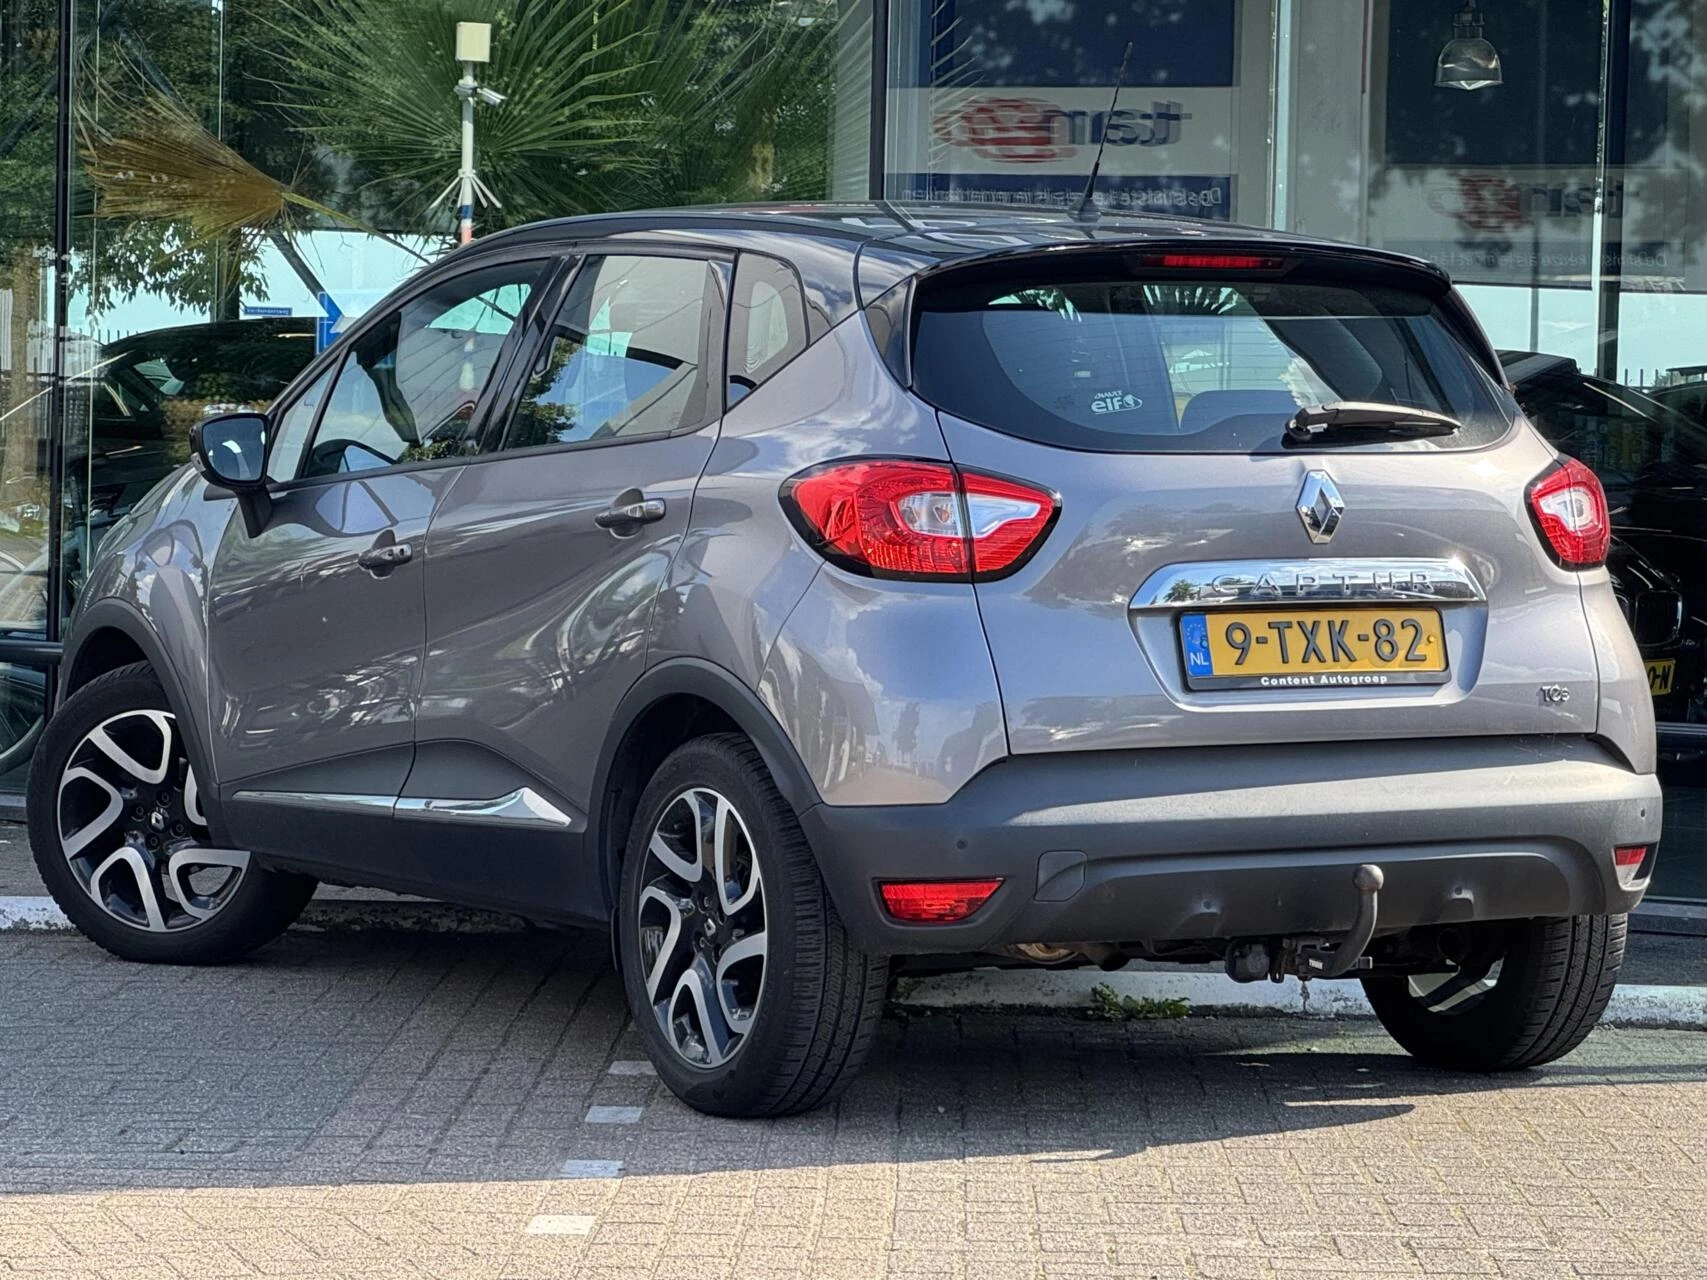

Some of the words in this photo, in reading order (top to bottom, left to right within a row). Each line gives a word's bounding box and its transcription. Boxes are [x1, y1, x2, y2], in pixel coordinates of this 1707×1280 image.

[1091, 397, 1122, 413] elf
[1211, 571, 1435, 596] CAPTUR
[1226, 618, 1427, 665] 9-TXK-82
[1190, 653, 1209, 667] NL
[1260, 675, 1315, 685] Content
[1320, 674, 1388, 685] Autogroep
